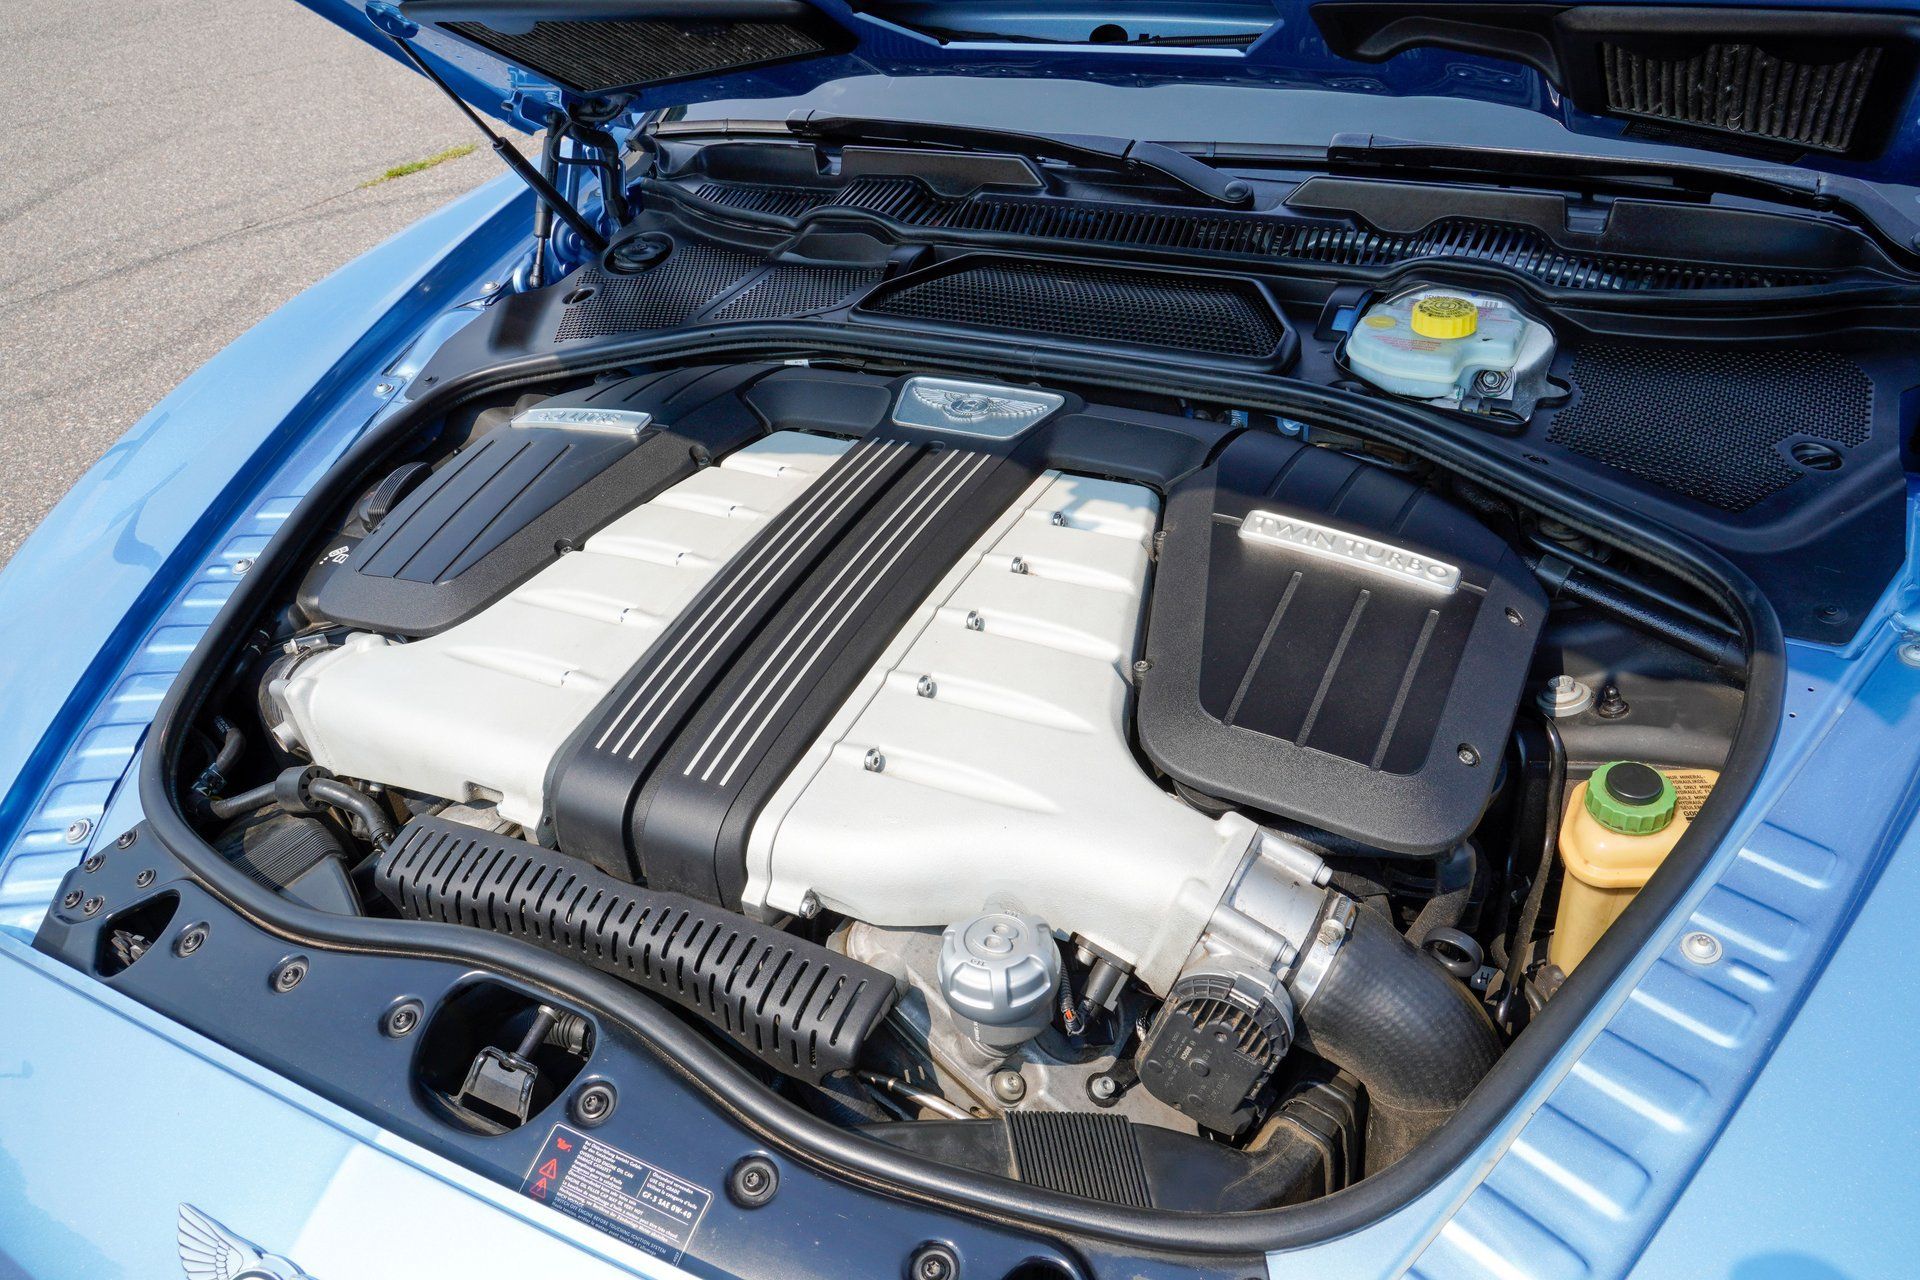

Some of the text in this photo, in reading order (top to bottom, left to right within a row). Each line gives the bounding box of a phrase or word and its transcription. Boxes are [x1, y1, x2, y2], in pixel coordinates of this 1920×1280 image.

[1254, 515, 1449, 580] TWIN TURBO
[577, 1155, 611, 1173] DAMAGE CATALYST
[579, 1151, 602, 1163] OVERFILLED
[602, 1161, 616, 1170] ENGINE
[565, 1175, 580, 1185] ENGINE
[587, 1186, 600, 1194] FILLER
[666, 1186, 680, 1194] GRADE
[642, 1191, 692, 1218] GF-3 SAE 0W-40
[554, 1197, 570, 1207] SWITCH
[578, 1208, 593, 1218] ENGINE
[593, 1216, 608, 1225] BEFORE
[609, 1223, 631, 1236] TOUCHING
[631, 1234, 650, 1246] IGNITION
[651, 1243, 666, 1253] SYSTEM
